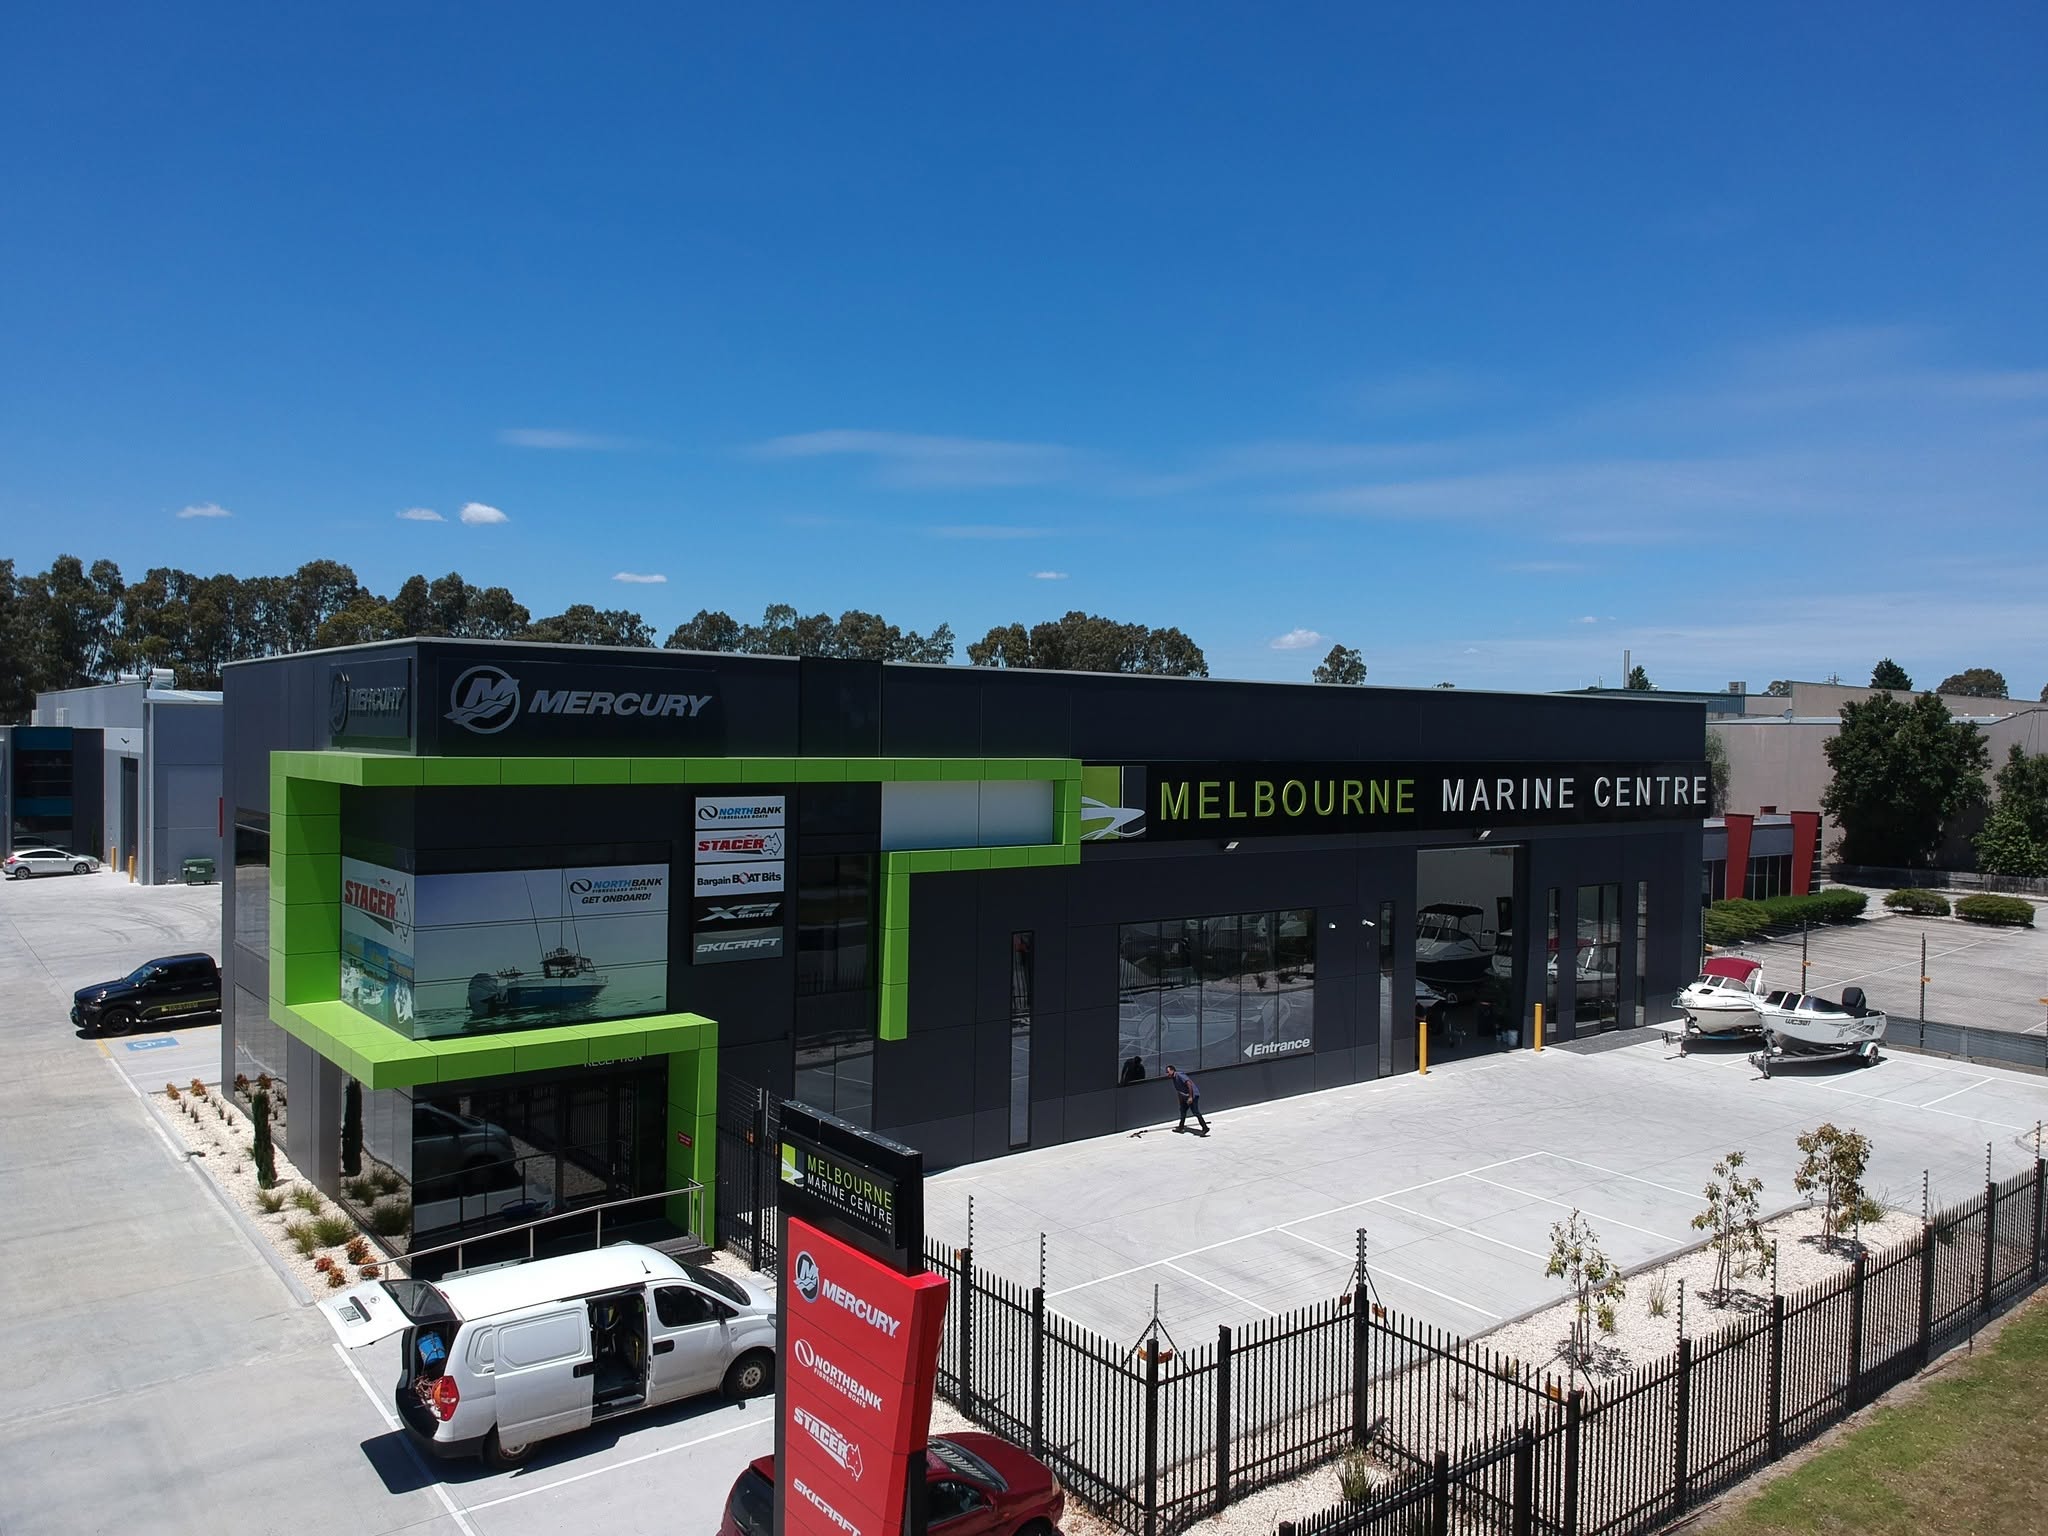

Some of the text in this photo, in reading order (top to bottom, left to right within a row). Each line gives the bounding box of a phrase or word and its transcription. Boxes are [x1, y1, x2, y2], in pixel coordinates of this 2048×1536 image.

[528, 690, 712, 717] MERCURY
[719, 806, 782, 816] NORTHBANK
[1160, 776, 1707, 820] MELBOURNE MARINE CENTRE
[698, 838, 764, 851] STACER
[345, 879, 397, 920] STACER
[582, 893, 652, 904] GET ONBOARD!
[593, 878, 662, 889] NORTHBANK
[697, 872, 782, 887] Bargain BOAT Bits
[696, 938, 780, 953] SKICRAFT
[1253, 1038, 1310, 1056] Entrance
[807, 1154, 892, 1210] MELBOURNE
[807, 1172, 892, 1225] MARINE CENTRE
[821, 1278, 900, 1337] MERCURY
[814, 1367, 866, 1409] FIBREGLASS BOATS
[815, 1354, 882, 1412] NORTHBANK
[793, 1407, 848, 1460] STACER
[793, 1478, 861, 1536] SKICRAFT
